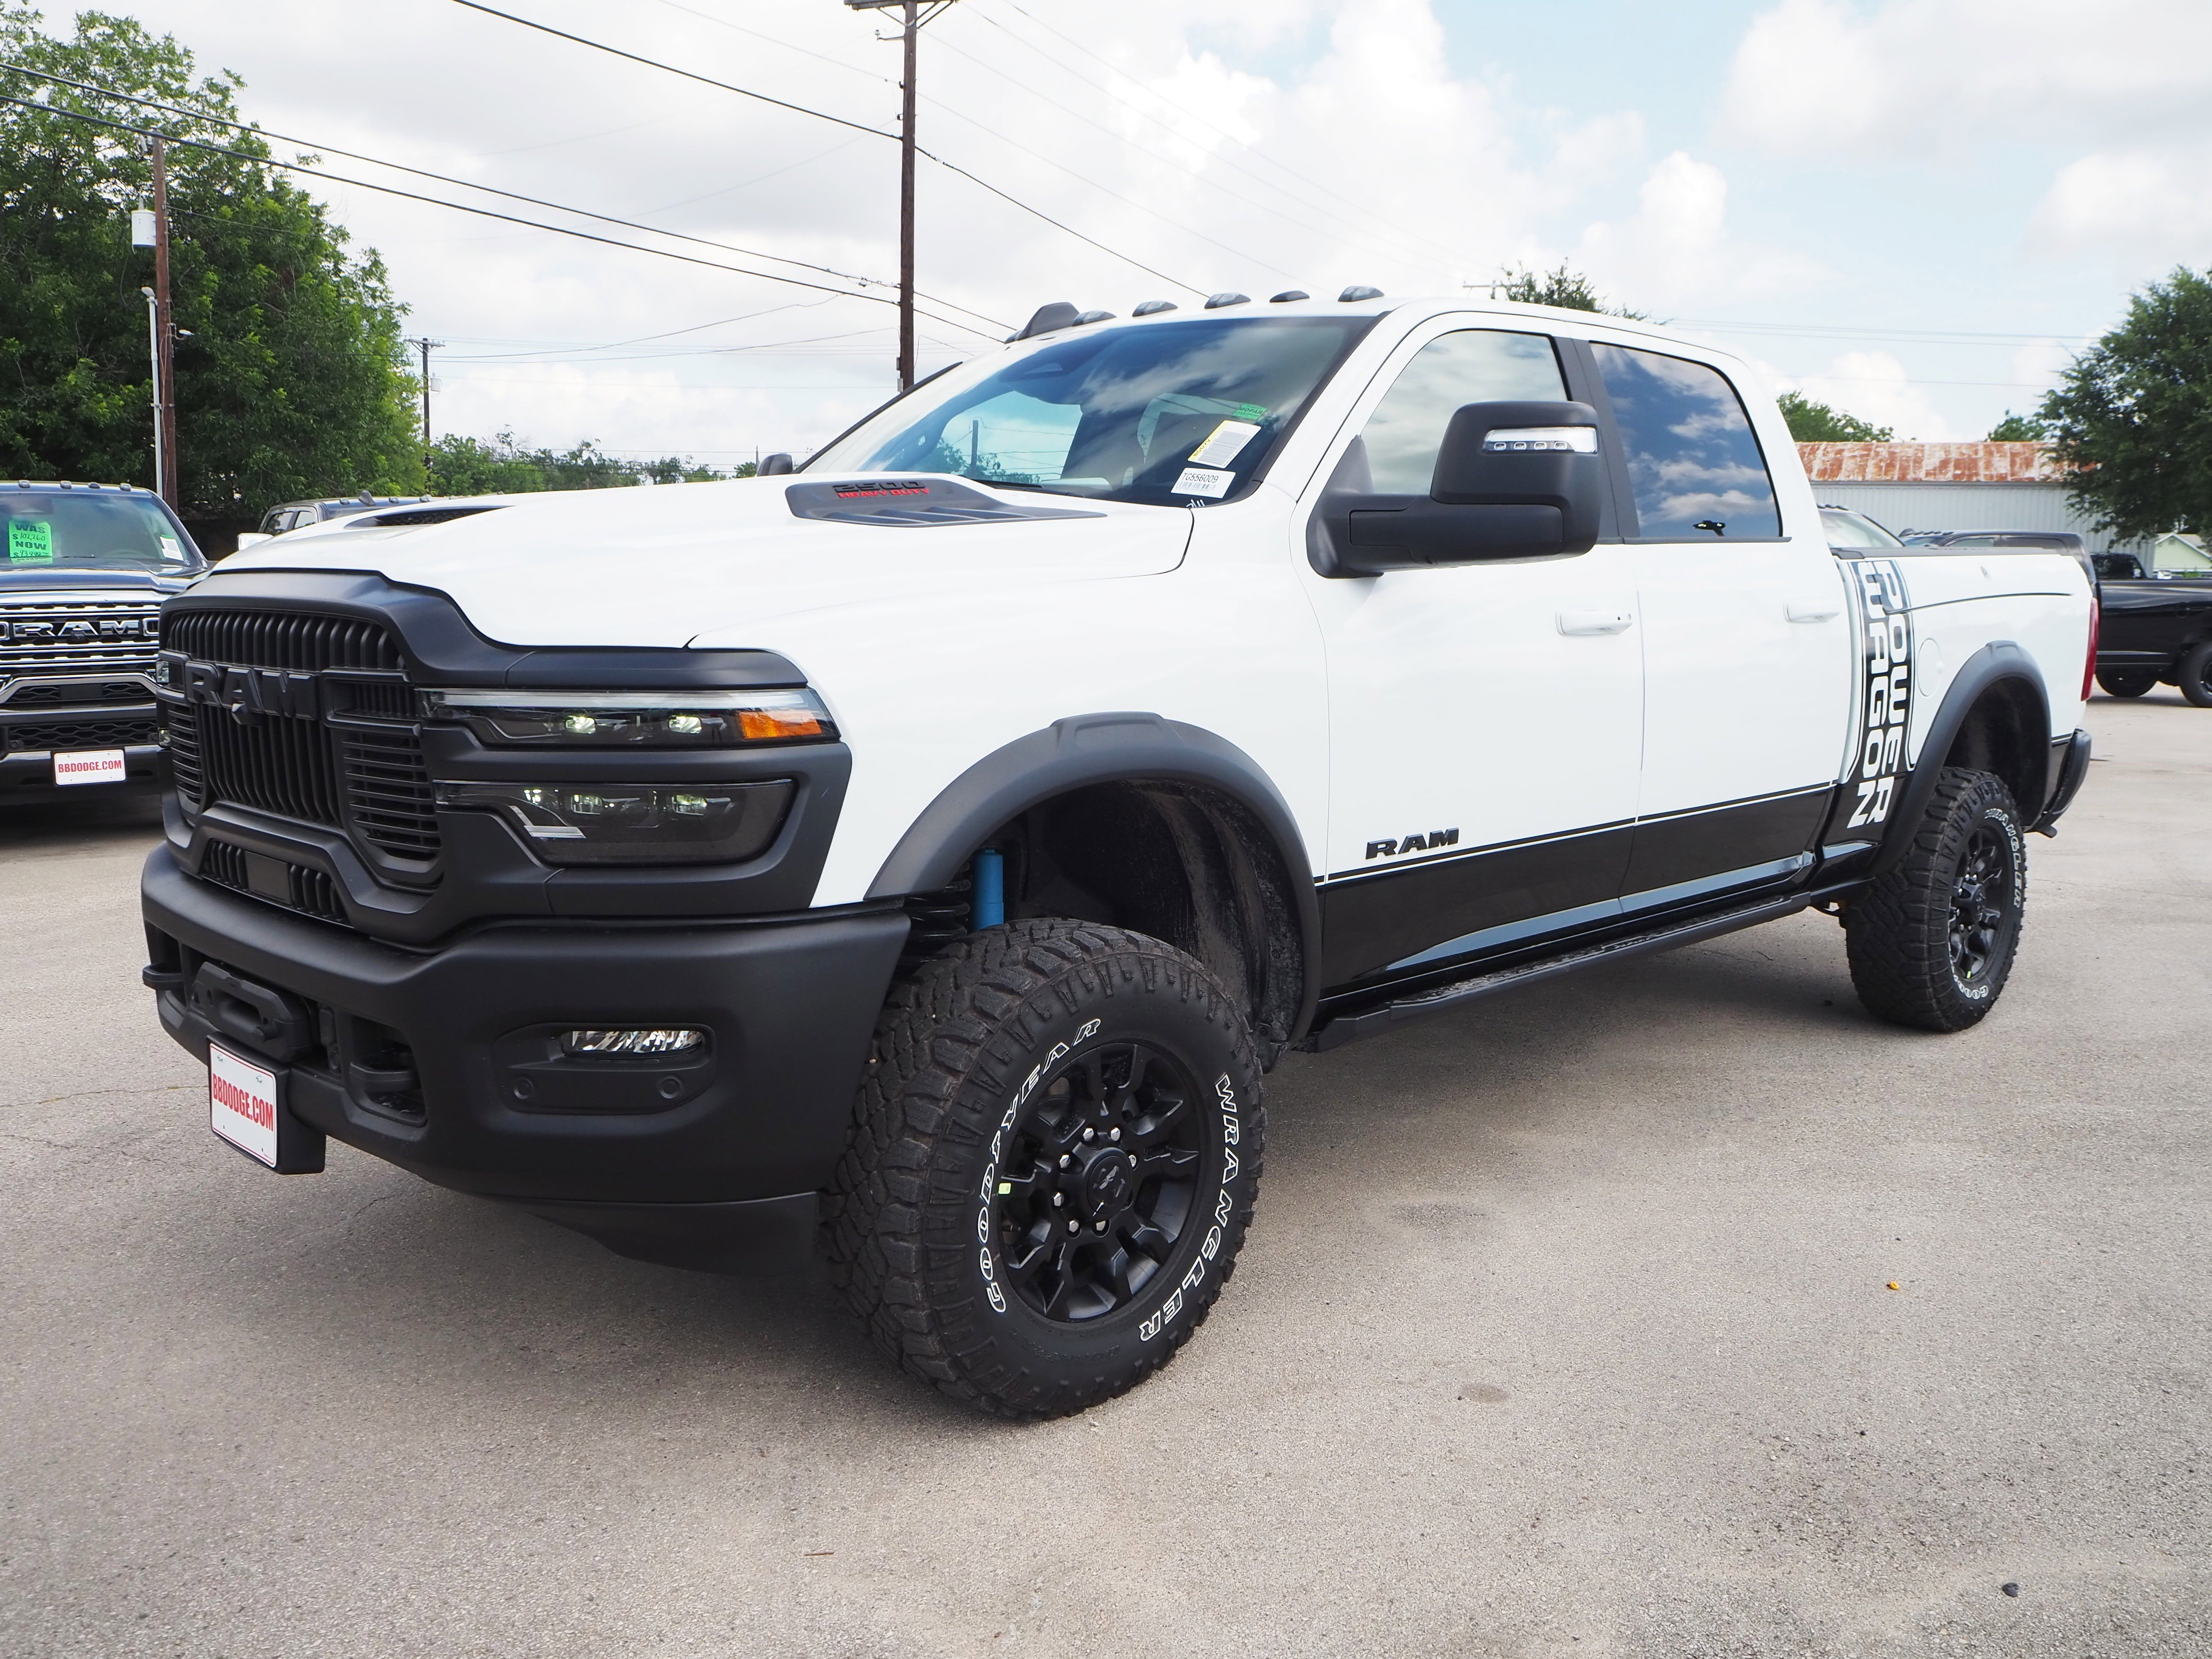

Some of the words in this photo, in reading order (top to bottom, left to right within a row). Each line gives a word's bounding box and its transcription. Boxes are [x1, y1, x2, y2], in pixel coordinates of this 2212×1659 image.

[833, 482, 926, 492] 2500
[1181, 472, 1219, 483] TG556009
[15, 524, 45, 533] WAS
[15, 541, 47, 550] NOW
[13, 621, 139, 636] RAM
[185, 661, 318, 720] RAM
[1847, 562, 1889, 829] WAGON
[1867, 561, 1908, 823] POWER
[58, 760, 121, 773] BBDODGE.COM
[1366, 827, 1459, 859] RAM
[213, 1073, 273, 1131] BBDODGE.COM
[978, 1019, 1101, 1313] GOODYEAR
[1140, 1073, 1239, 1341] WRANGLER
